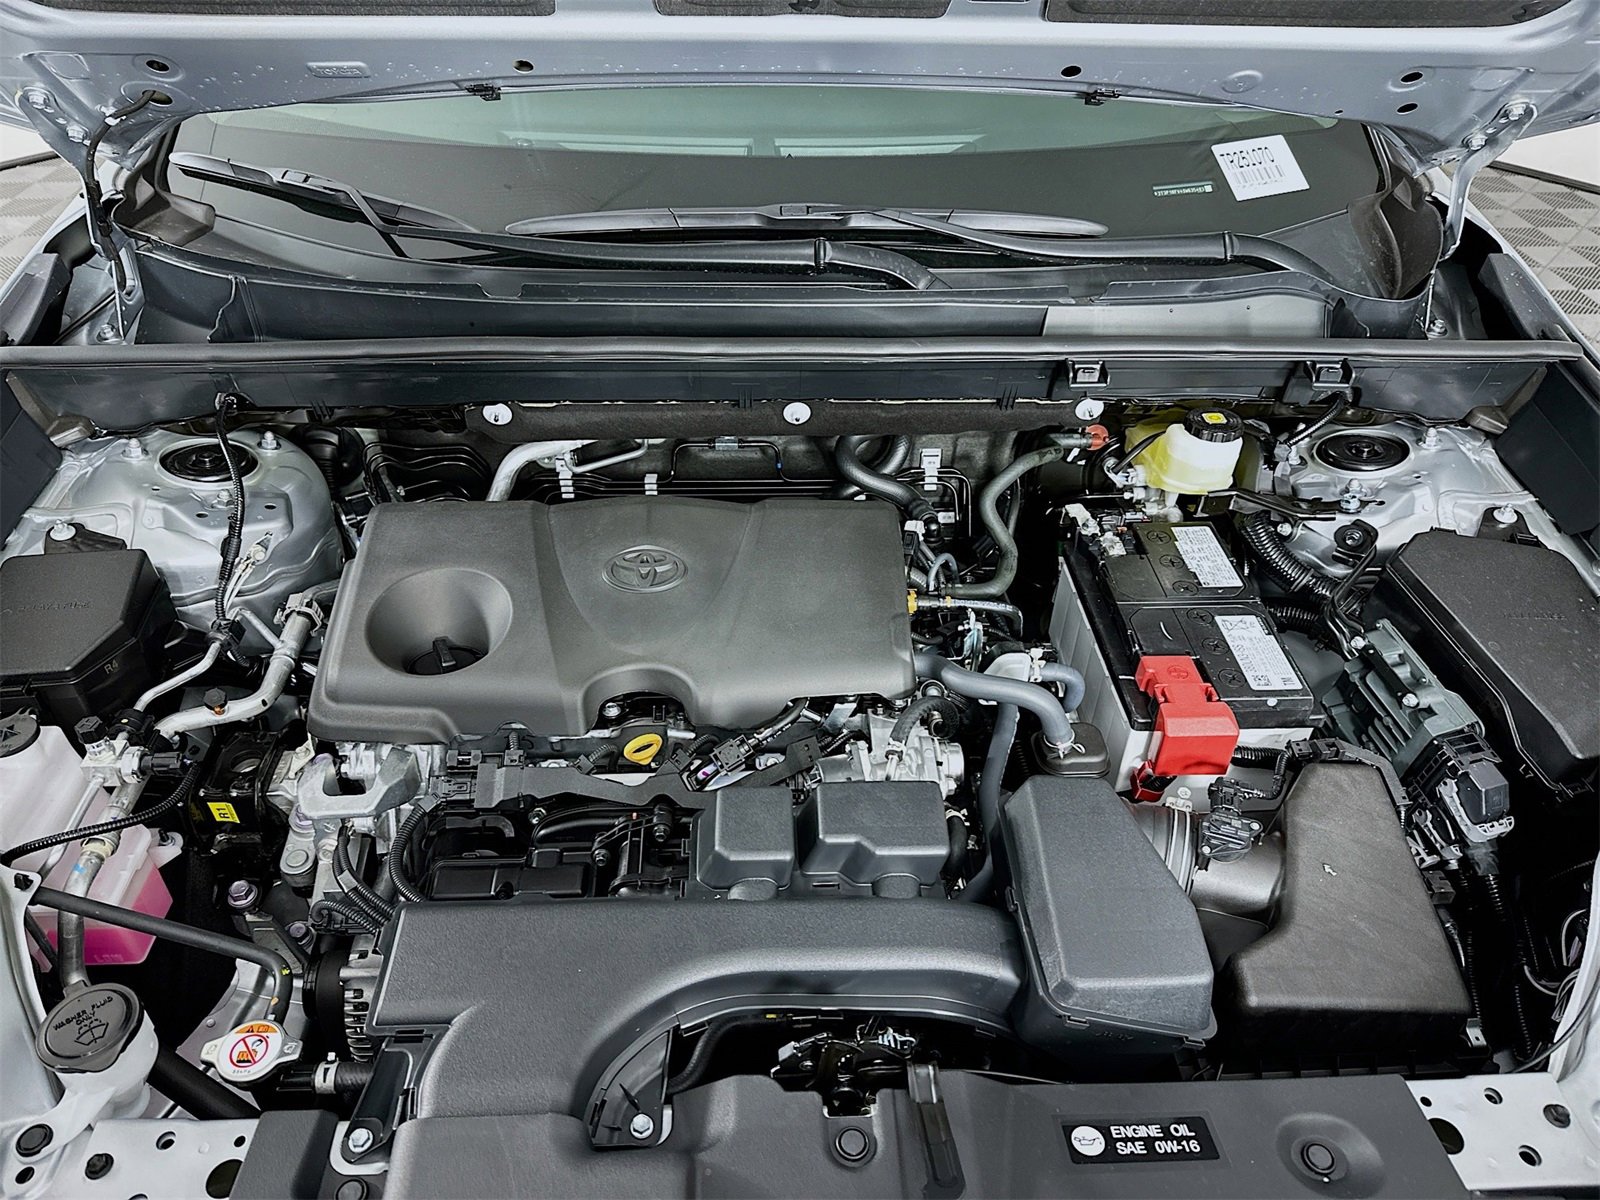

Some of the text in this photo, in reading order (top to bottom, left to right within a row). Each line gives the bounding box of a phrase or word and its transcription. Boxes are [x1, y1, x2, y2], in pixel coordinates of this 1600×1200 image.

[1219, 146, 1275, 171] TR251070
[104, 659, 119, 674] R4
[1519, 763, 1535, 779] L7
[215, 807, 231, 819] R1
[76, 1011, 96, 1026] ONLY
[1109, 1123, 1196, 1138] ENGINE OIL
[1115, 1139, 1201, 1155] SAE 0W-16
